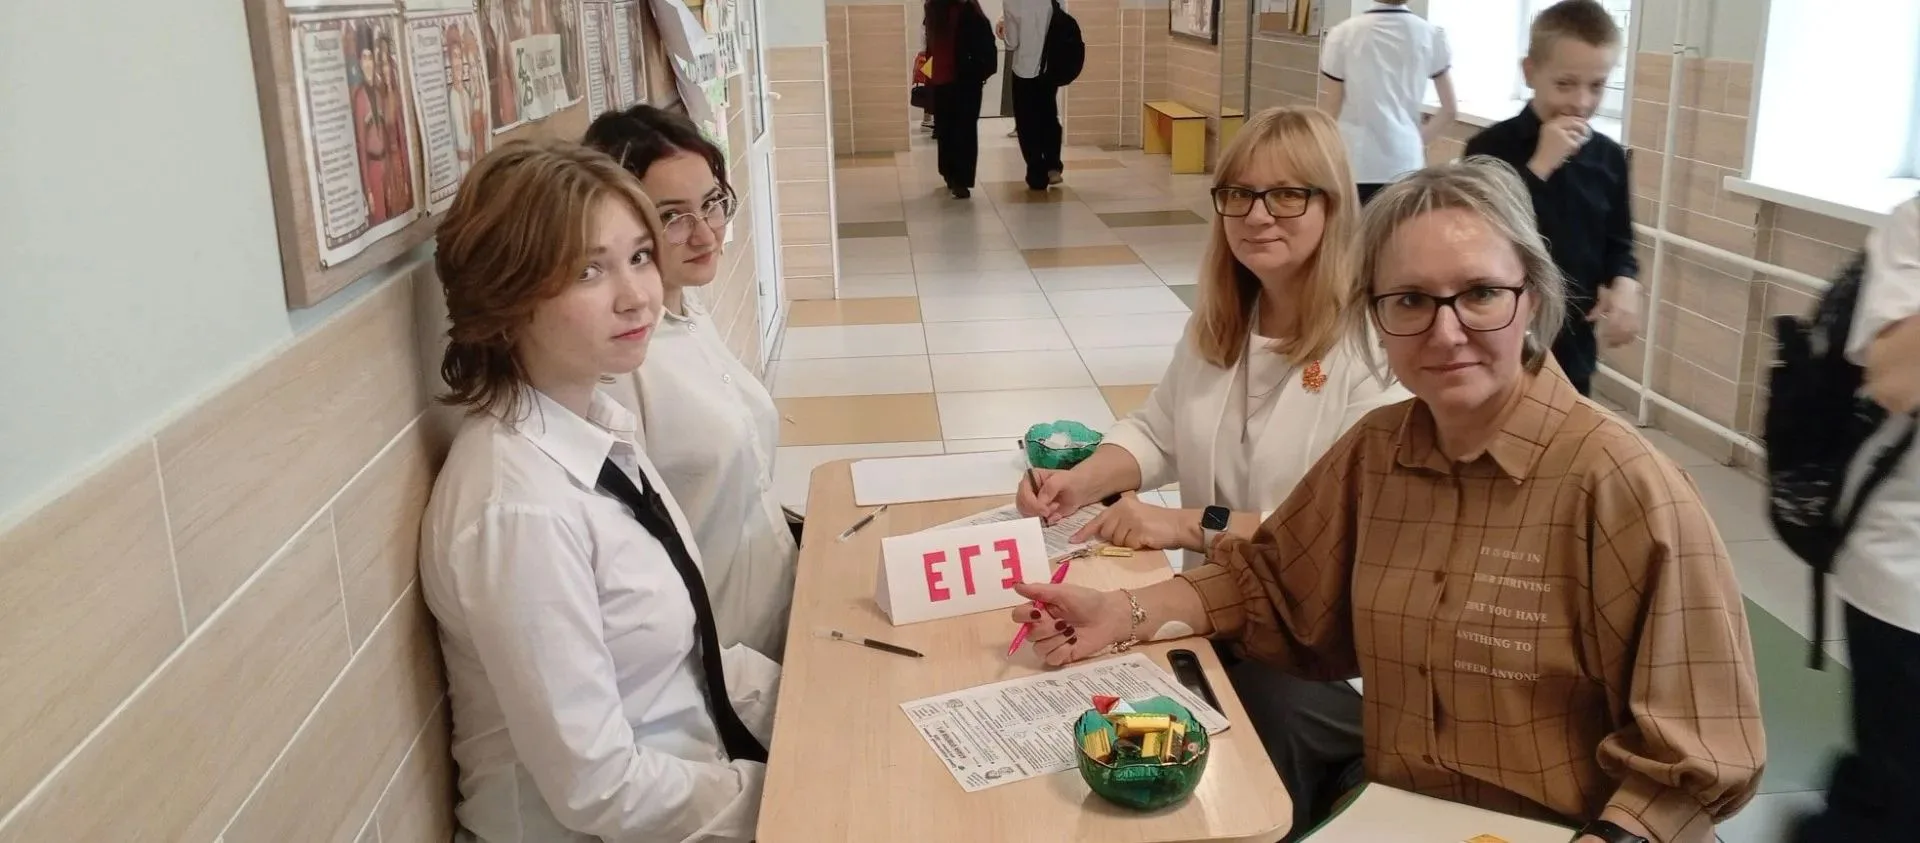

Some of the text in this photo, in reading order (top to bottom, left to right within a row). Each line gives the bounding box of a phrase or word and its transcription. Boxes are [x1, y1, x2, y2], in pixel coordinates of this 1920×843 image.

[1528, 553, 1541, 563] IN
[923, 538, 1023, 602] ЕГЭ
[1498, 576, 1551, 592] THRIVING
[1489, 604, 1511, 618] YOU
[1516, 610, 1548, 622] HAVE
[1457, 630, 1532, 652] ANYTHING TO
[1454, 660, 1541, 681] OFFER ANYONE
